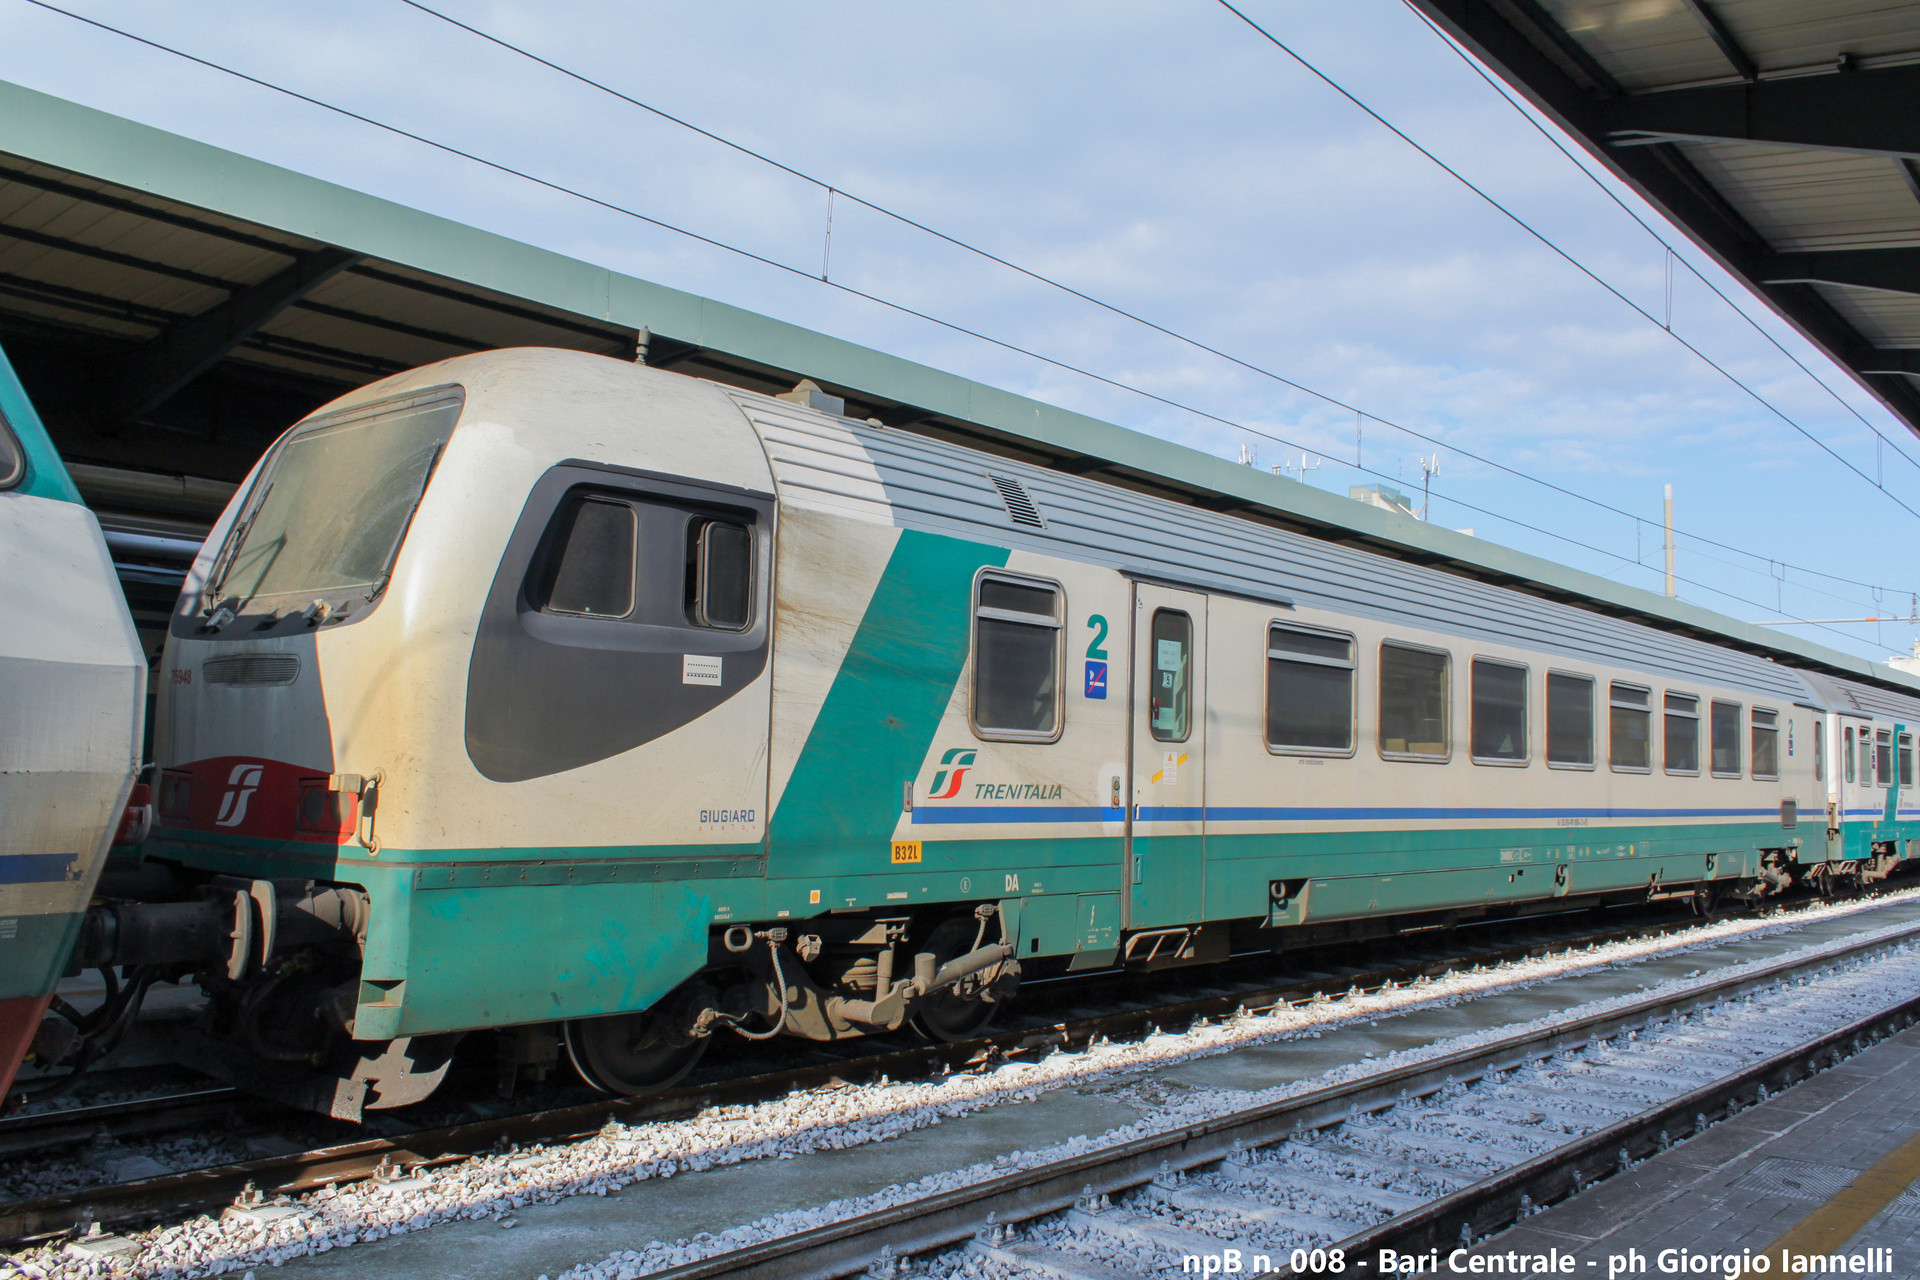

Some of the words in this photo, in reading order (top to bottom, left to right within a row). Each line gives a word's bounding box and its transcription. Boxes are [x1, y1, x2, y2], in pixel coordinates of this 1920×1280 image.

[1086, 614, 1109, 660] 2
[975, 783, 1063, 800] TRENITALIA
[700, 809, 755, 823] GIUGIARO
[1005, 874, 1020, 893] DA
